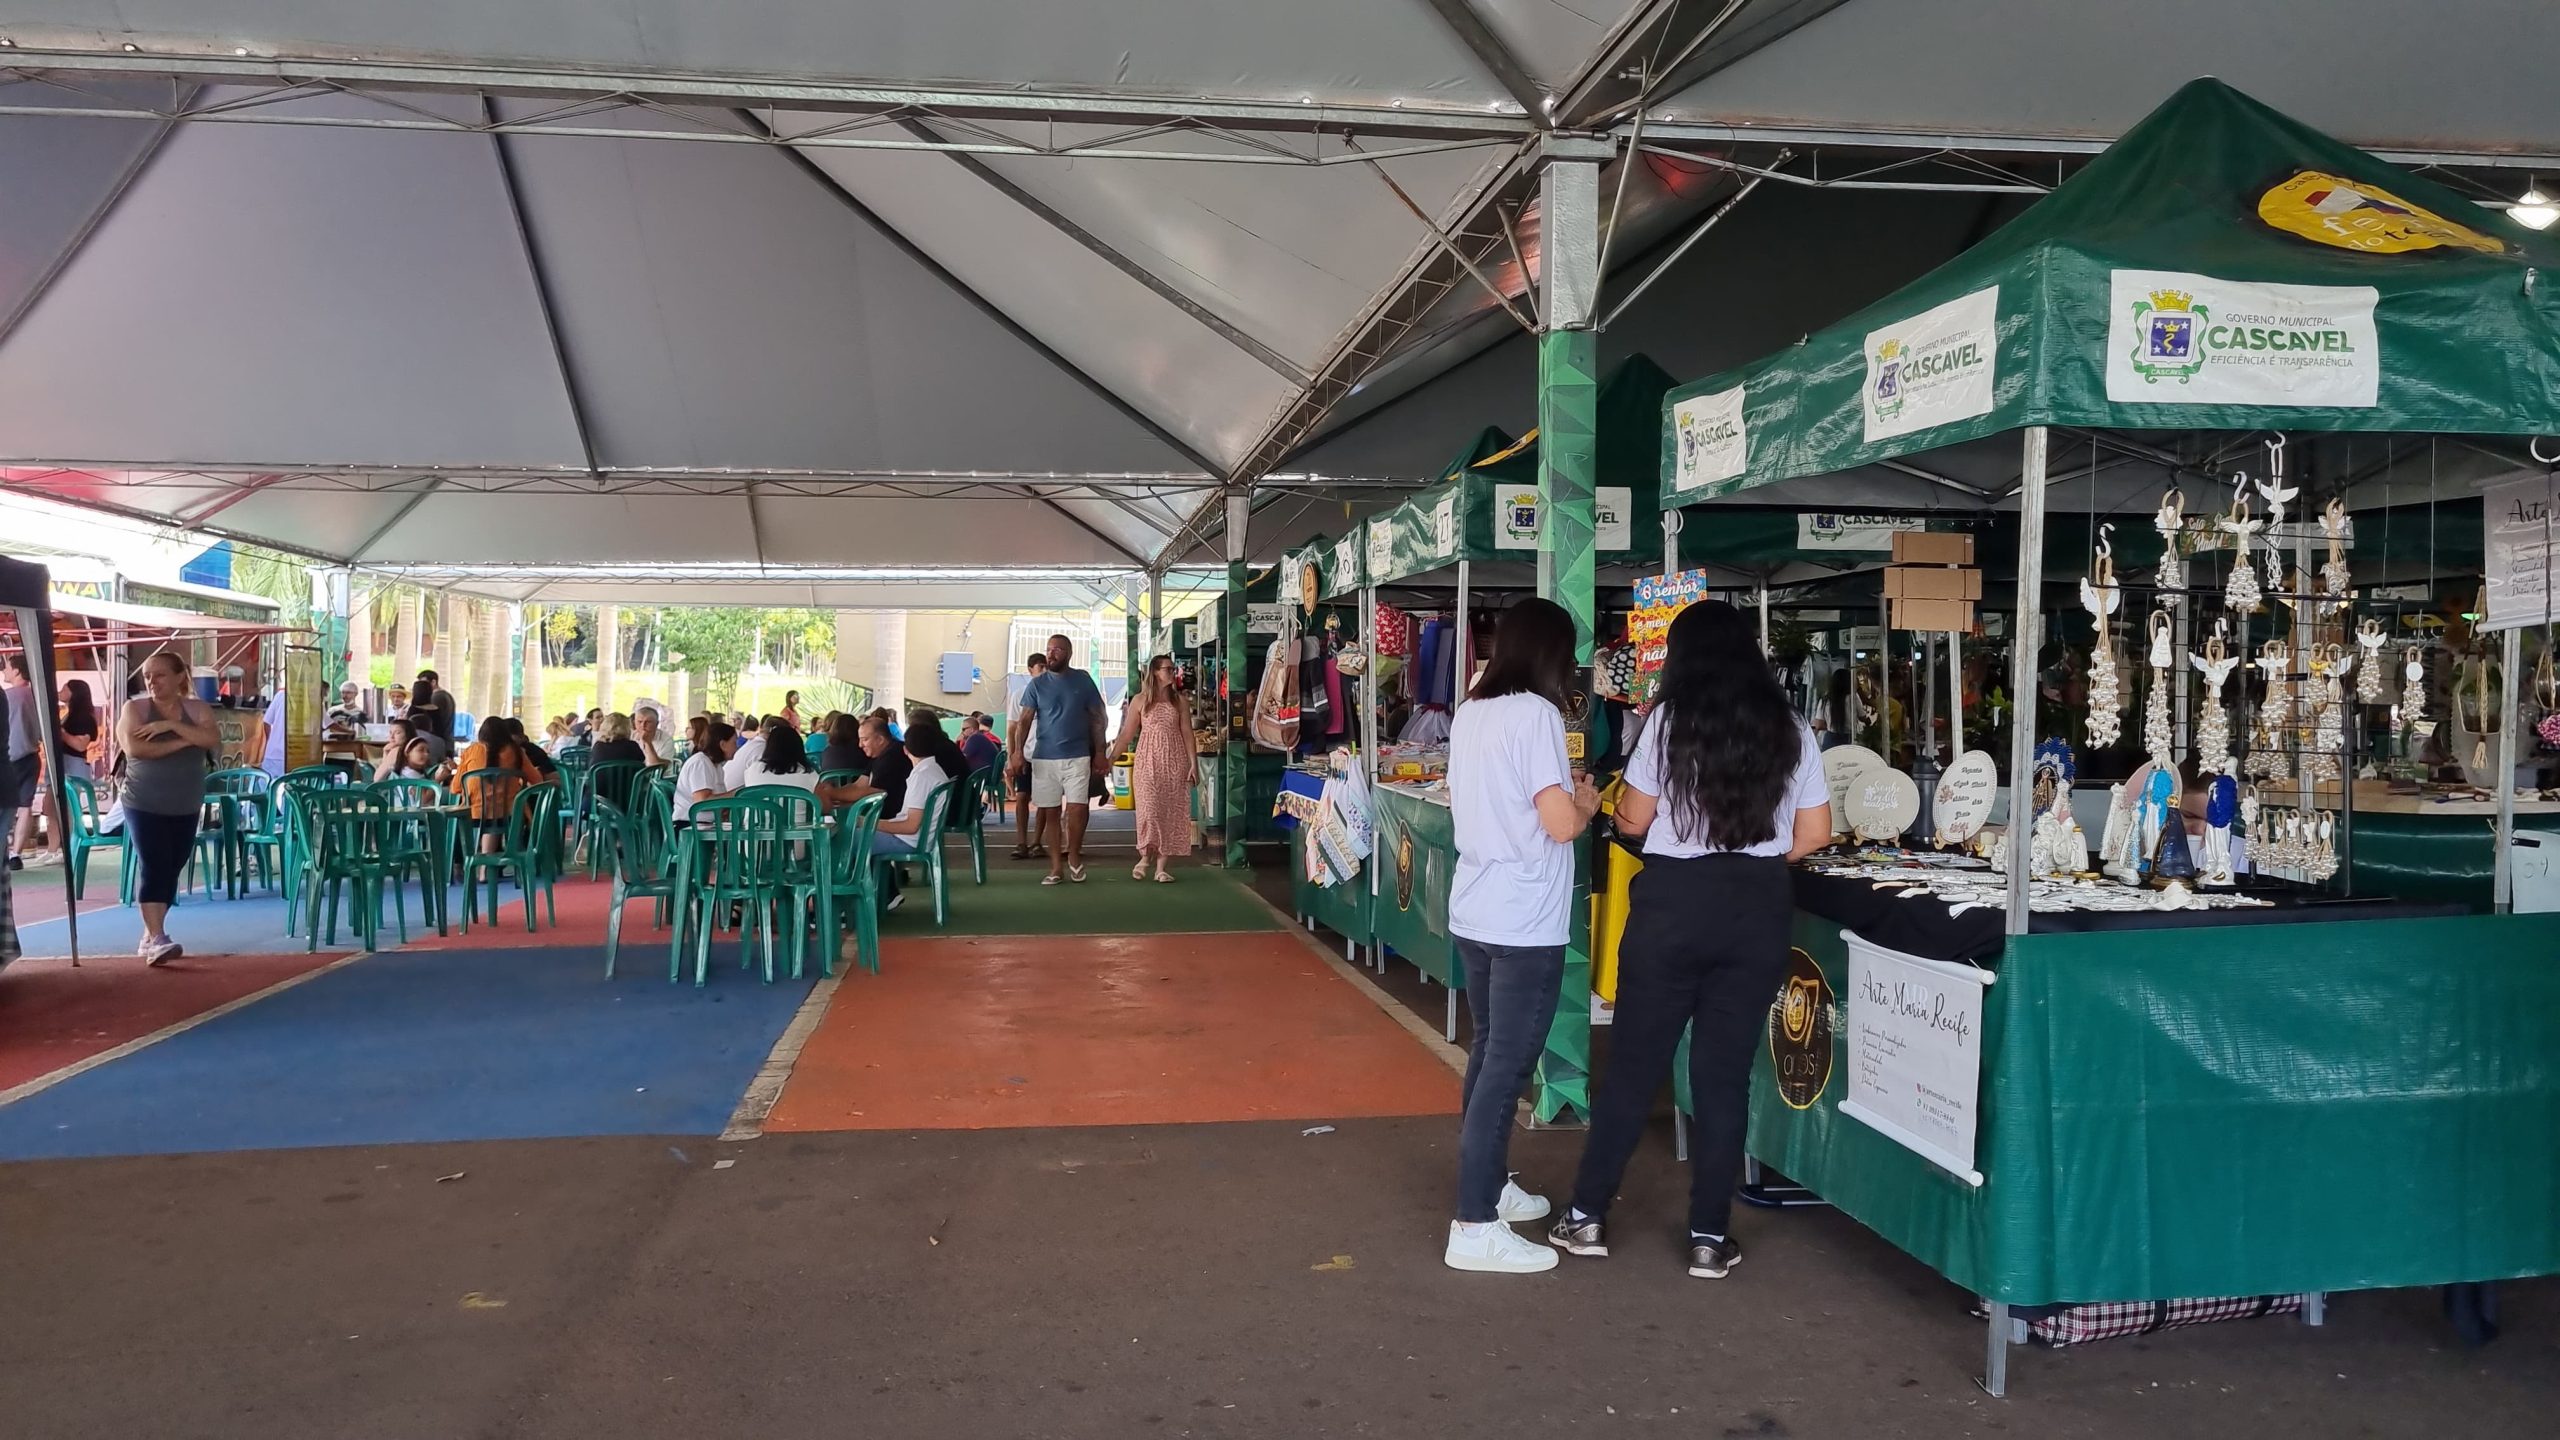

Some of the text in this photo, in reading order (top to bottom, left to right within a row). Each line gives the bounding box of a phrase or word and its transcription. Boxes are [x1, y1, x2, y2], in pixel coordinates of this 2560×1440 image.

[2225, 313, 2335, 327] GOVERNO MUNICIPAL
[2207, 325, 2356, 353] CASCAVEL
[1901, 342, 1984, 384] CASCAVEL
[2210, 354, 2266, 366] EFICIÊNCIA
[2278, 355, 2354, 368] TRANSPARÊNCIA
[1695, 420, 1739, 448] CASCAVEL
[1842, 514, 1915, 525] CASCAVEL
[1653, 579, 1700, 598] senhor
[1858, 969, 1889, 1006] Arte
[1890, 981, 1930, 1021] Maria
[1930, 992, 1971, 1048] Recife
